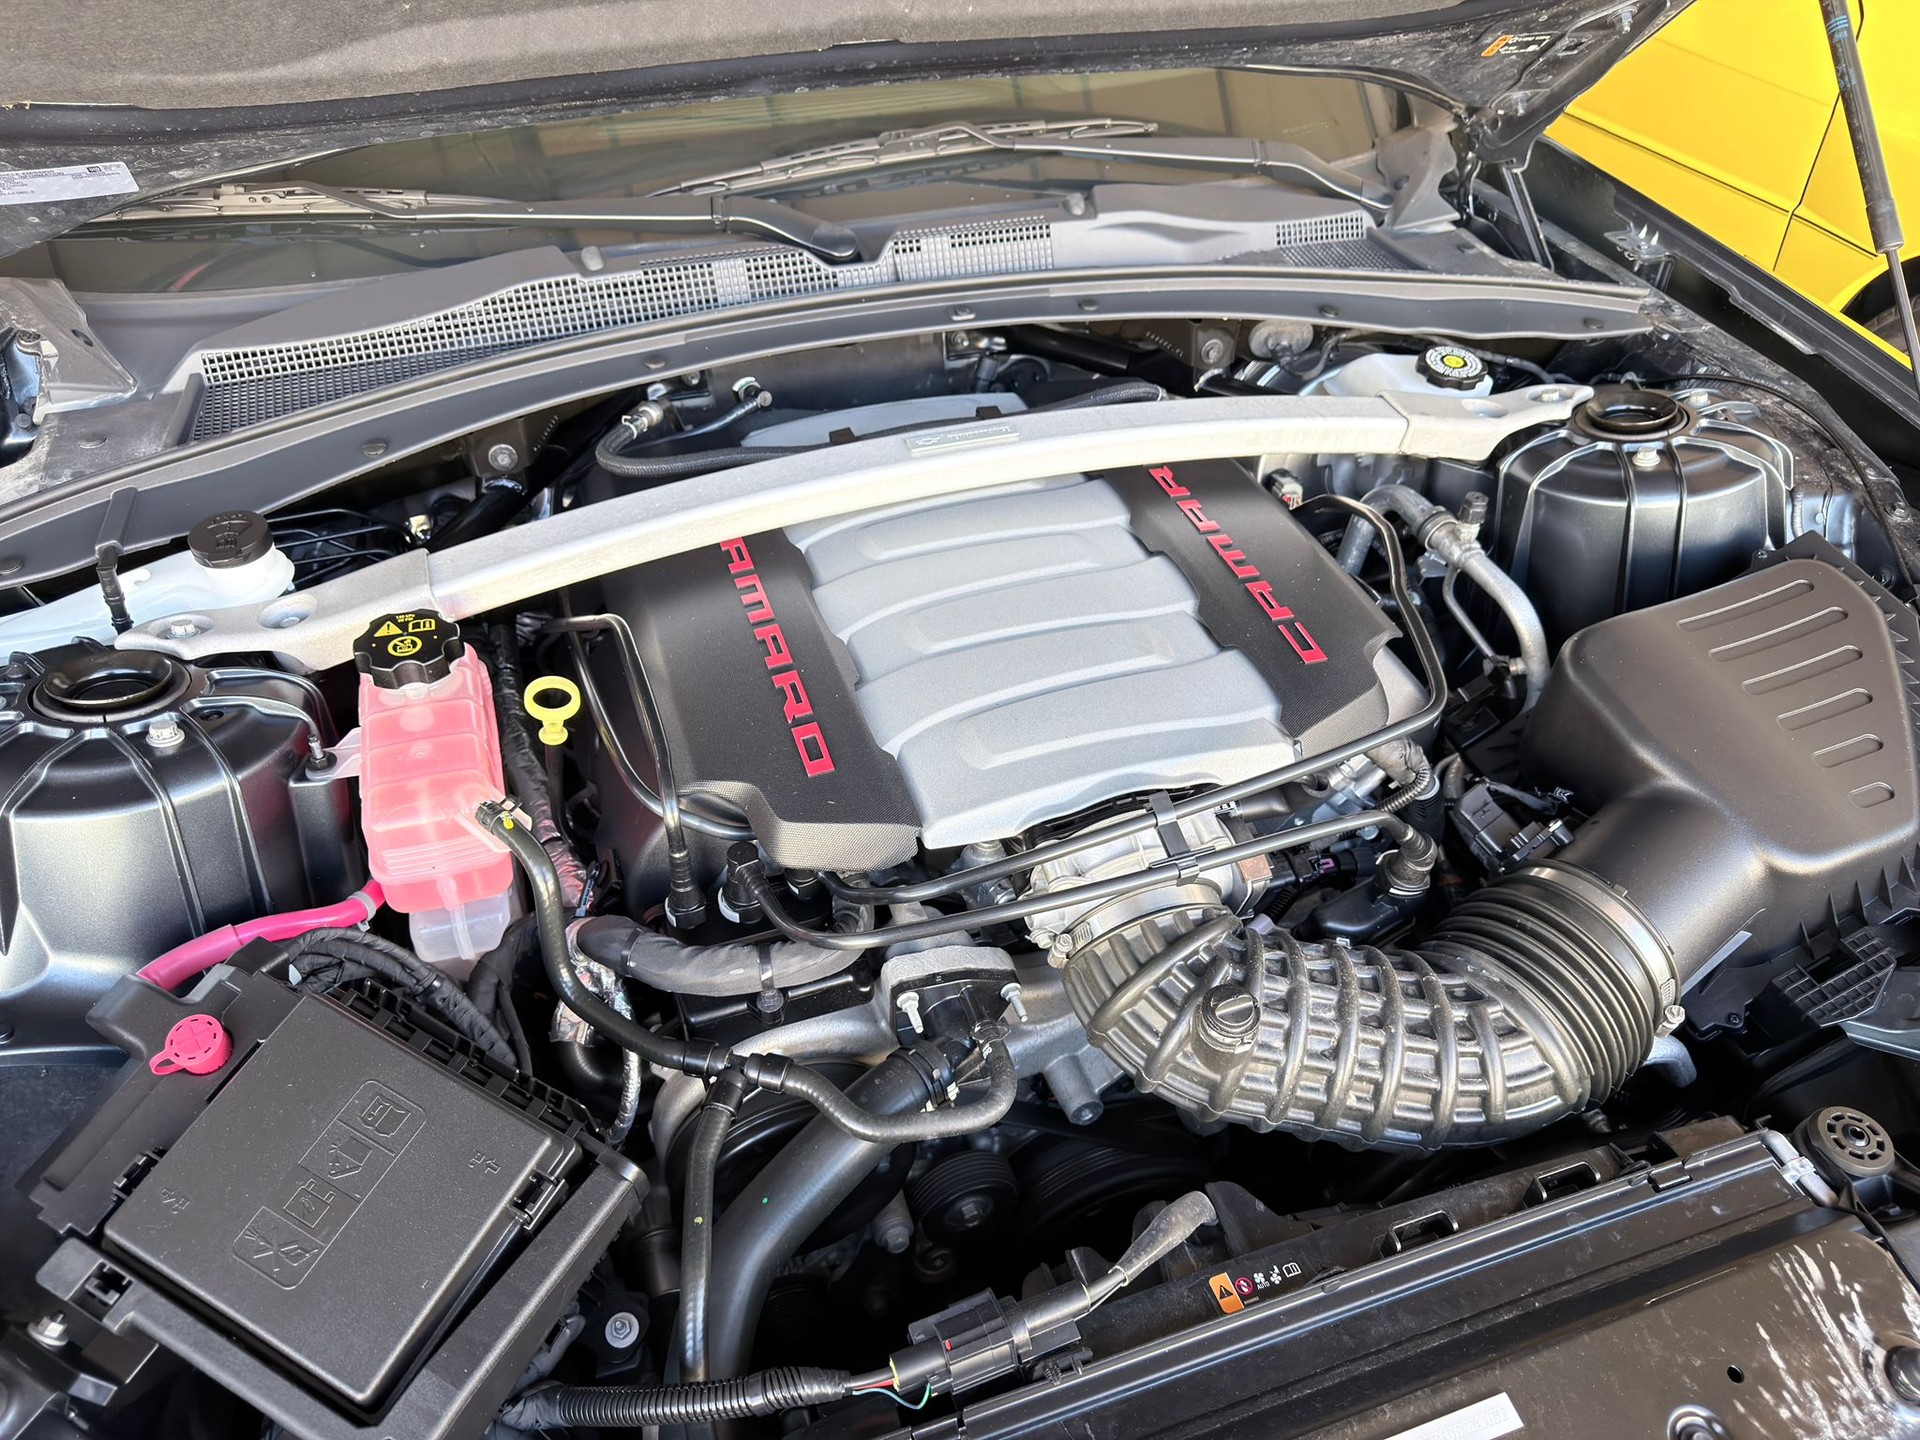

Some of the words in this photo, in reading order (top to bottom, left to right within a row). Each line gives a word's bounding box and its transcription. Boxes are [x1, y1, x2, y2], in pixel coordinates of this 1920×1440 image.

[720, 537, 835, 778] AMARO
[1149, 465, 1329, 664] CAMAR
[1257, 1281, 1270, 1290] AUTO
